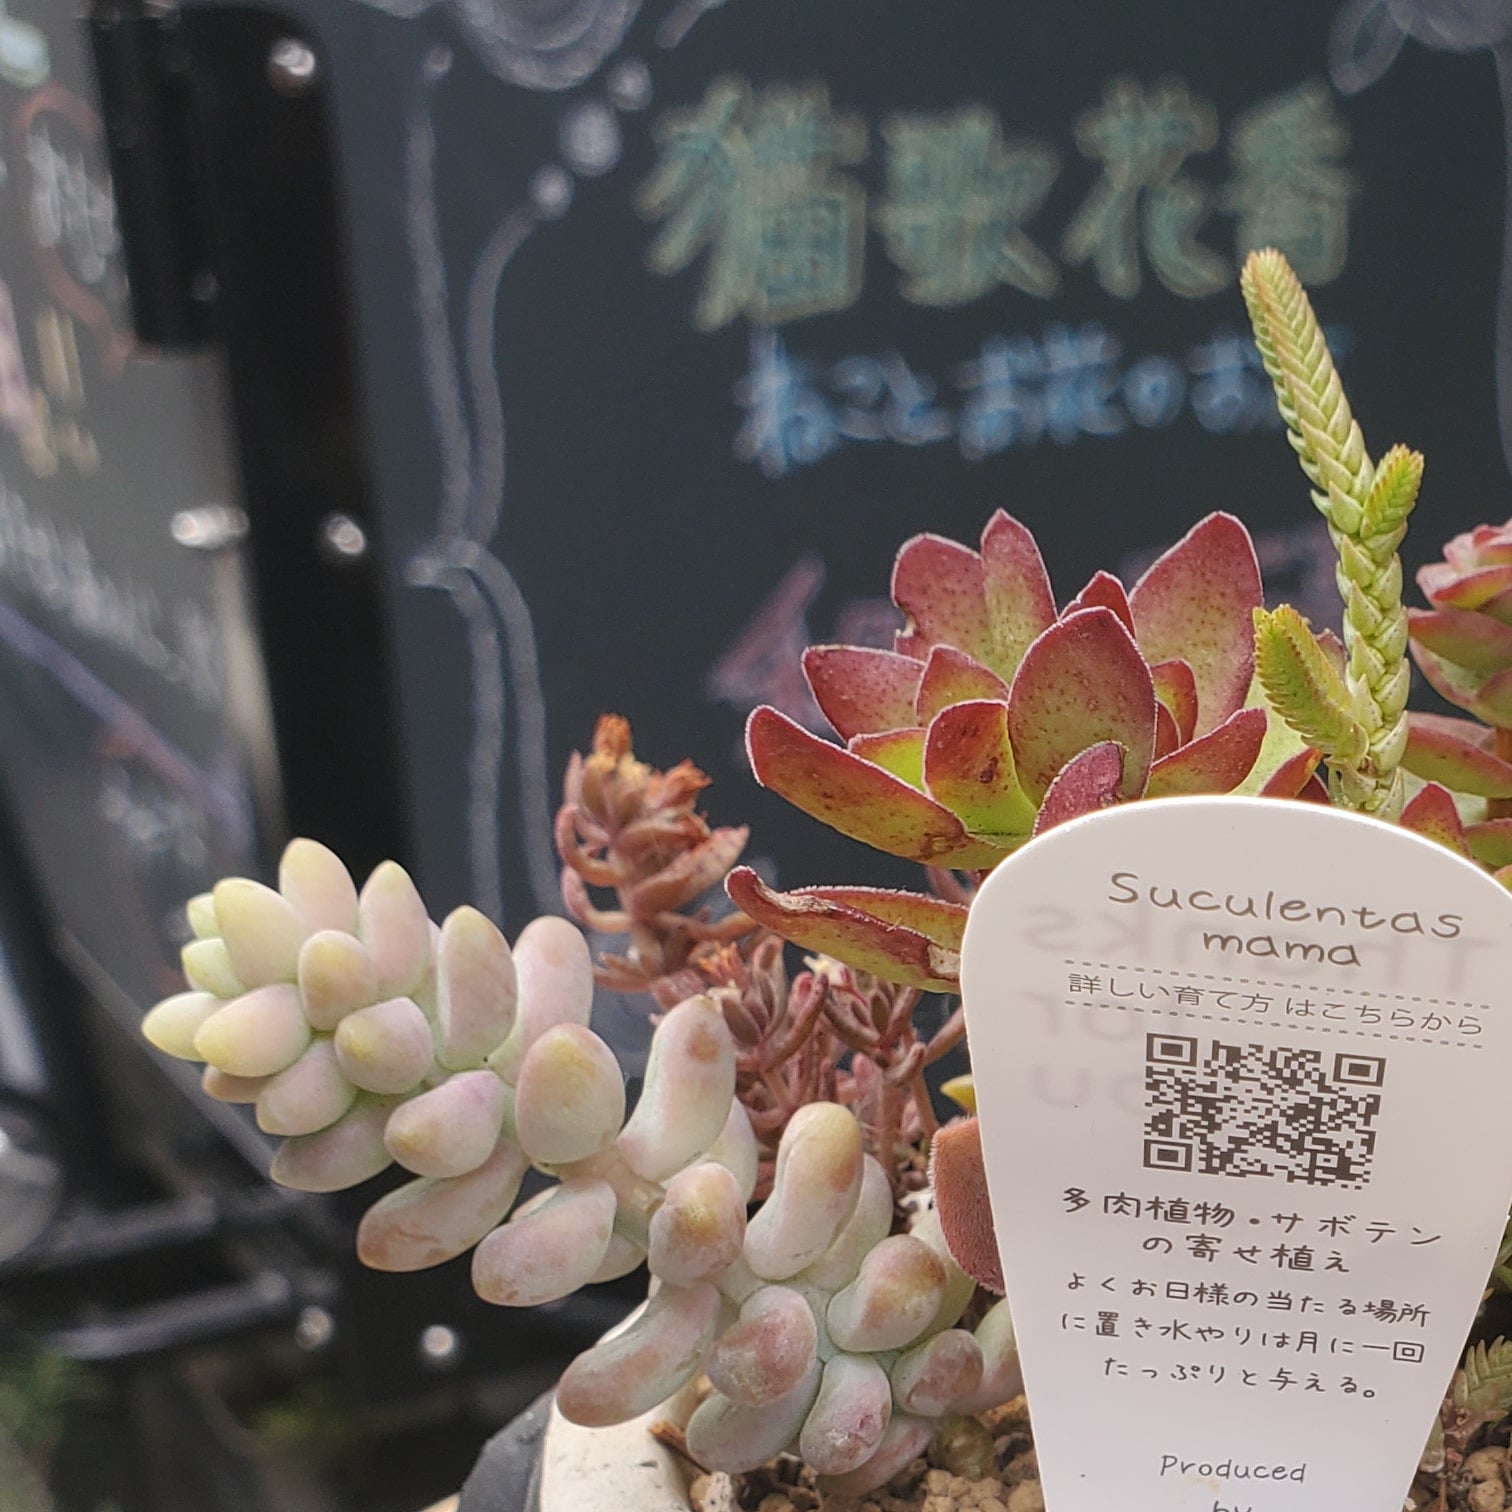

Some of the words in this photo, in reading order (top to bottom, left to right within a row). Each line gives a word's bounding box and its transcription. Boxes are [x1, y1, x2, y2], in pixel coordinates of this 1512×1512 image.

[1107, 871, 1464, 940] Suculentas
[1202, 929, 1362, 968] mama
[1141, 1233, 1351, 1274] の寄せ植え
[1066, 1271, 1433, 1329] よくお日様の当たる場所
[1060, 1311, 1427, 1365] に置き水やりは月に一回
[1103, 1356, 1377, 1400] たっぷりと与える。
[1159, 1453, 1308, 1485] Produced
